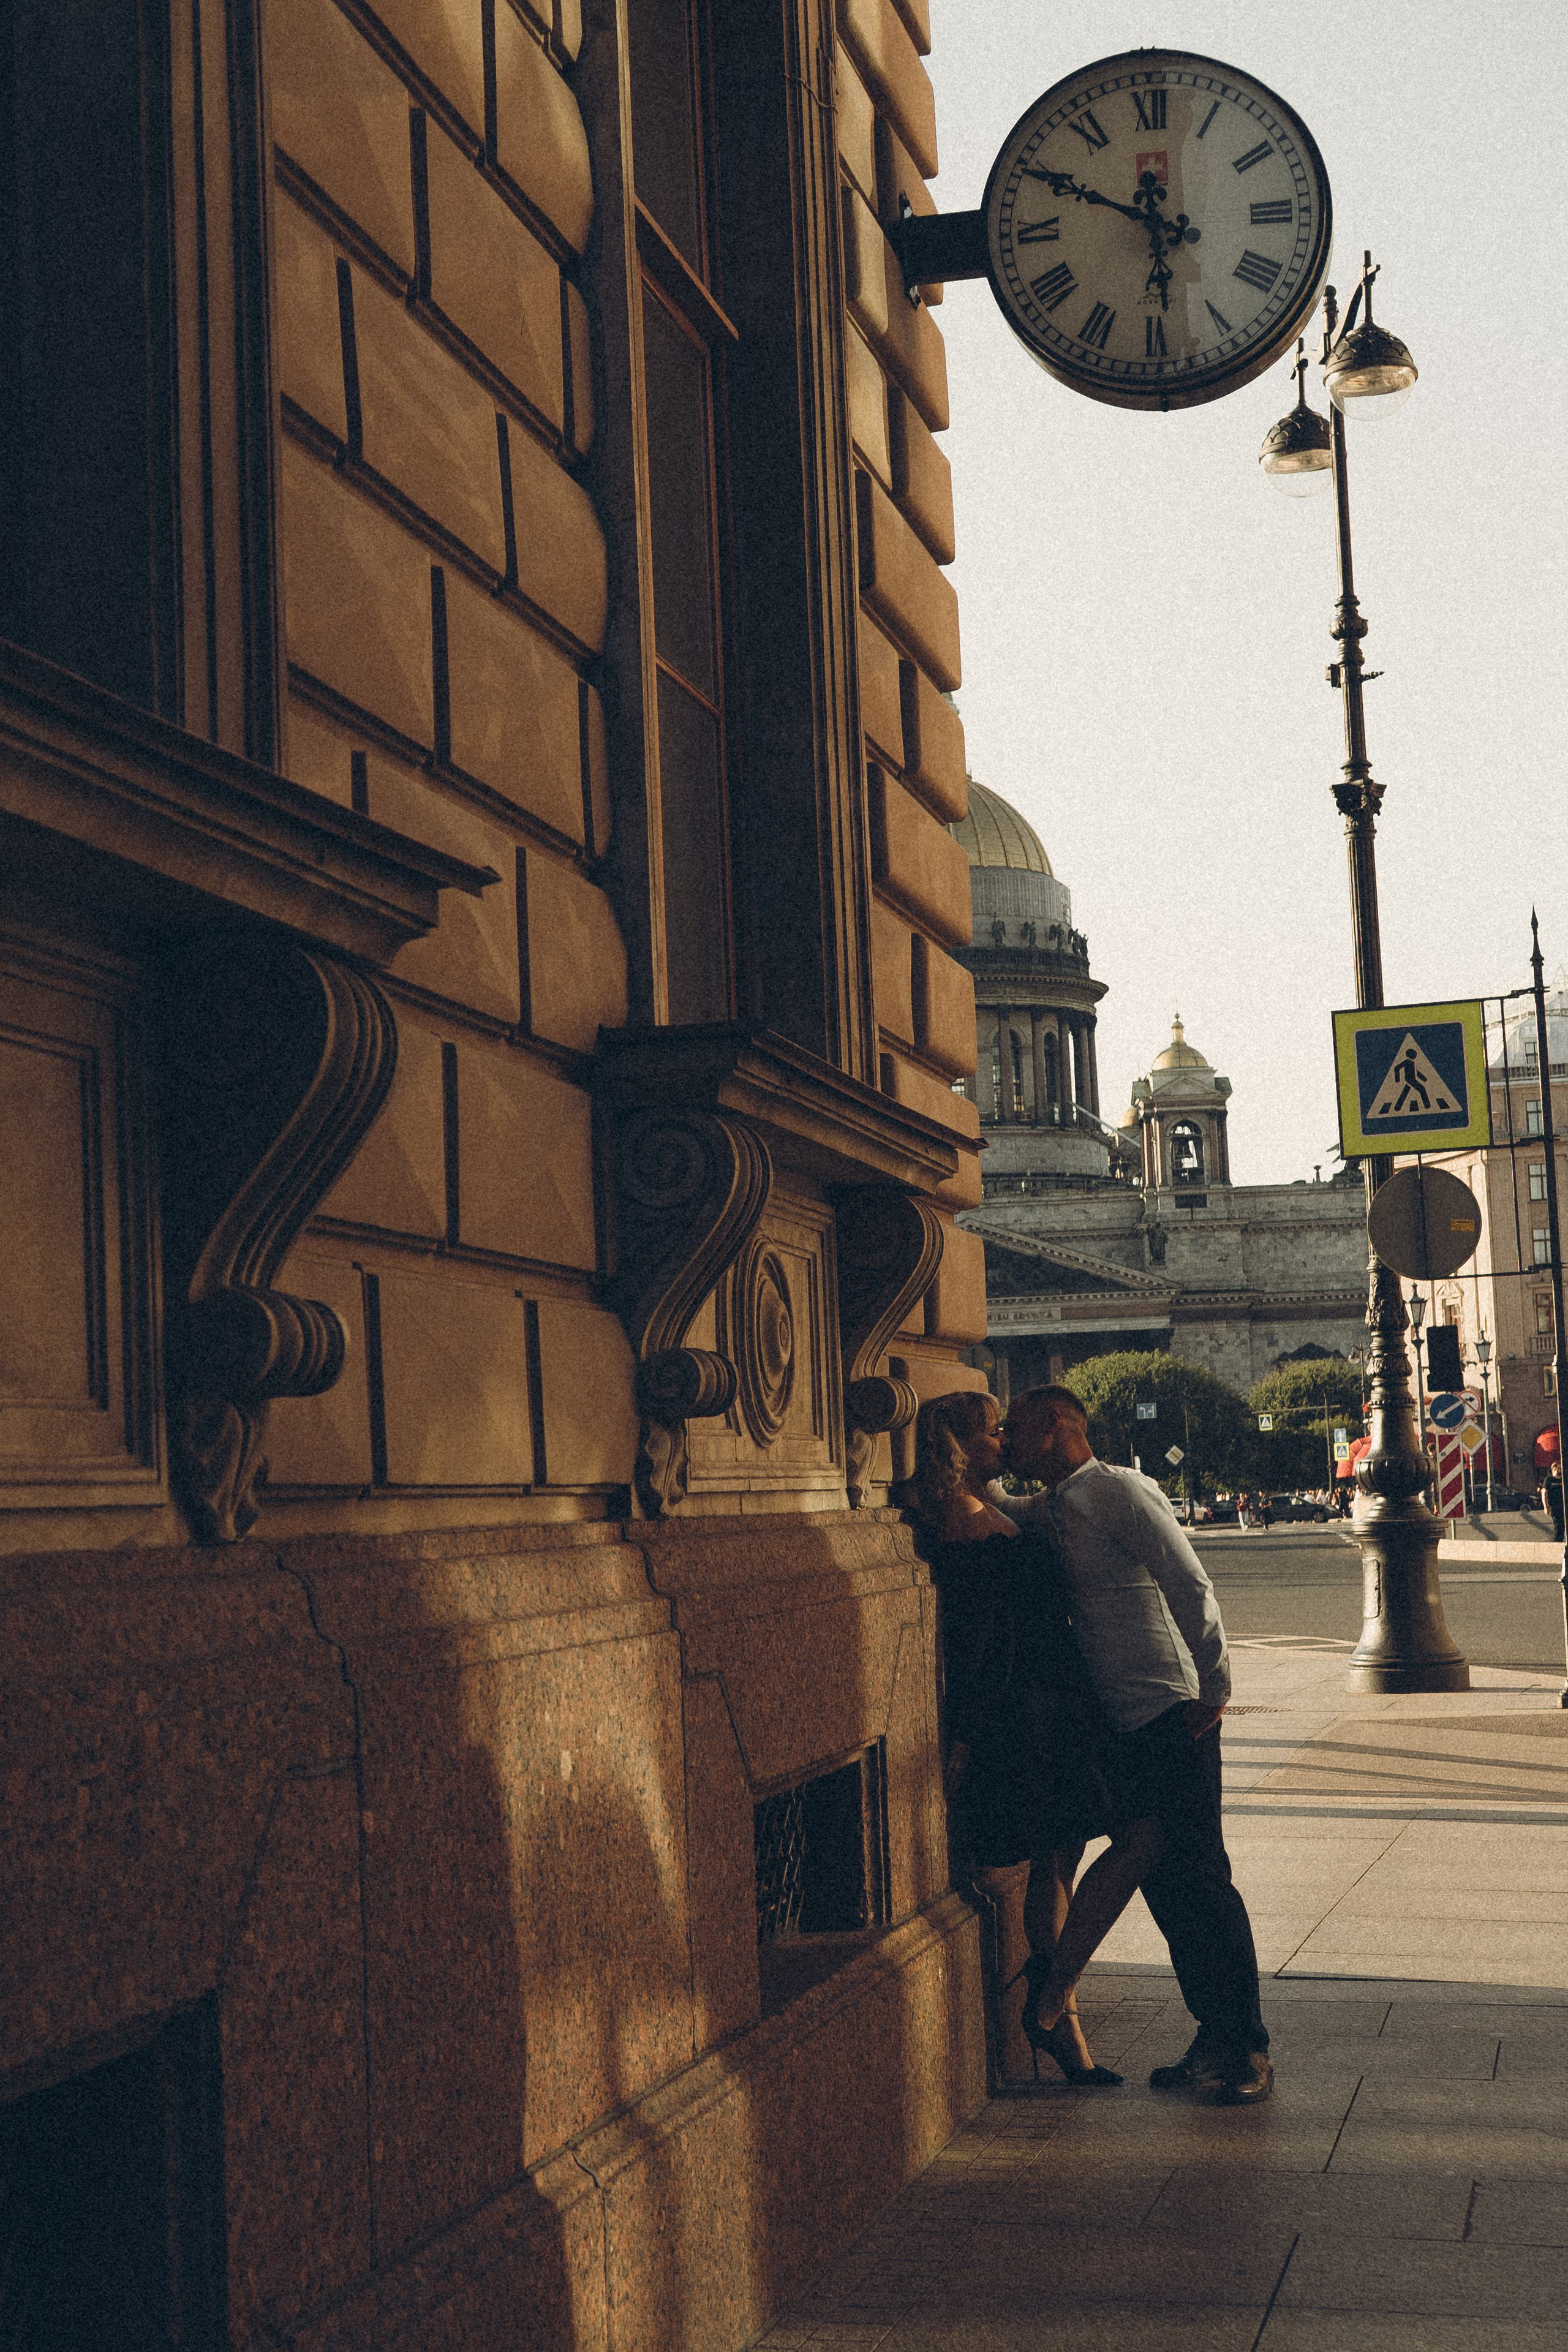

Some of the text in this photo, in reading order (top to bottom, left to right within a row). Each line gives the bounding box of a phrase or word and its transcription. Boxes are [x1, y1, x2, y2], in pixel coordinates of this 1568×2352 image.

[1131, 89, 1168, 132] XII
[1068, 109, 1111, 156] XI
[1232, 139, 1275, 175] II
[1018, 216, 1059, 245] IX
[1250, 198, 1292, 225] III
[1030, 261, 1079, 314] VIII
[1232, 249, 1284, 295] IIII
[1077, 301, 1117, 350] VII
[1145, 316, 1169, 357] VI
